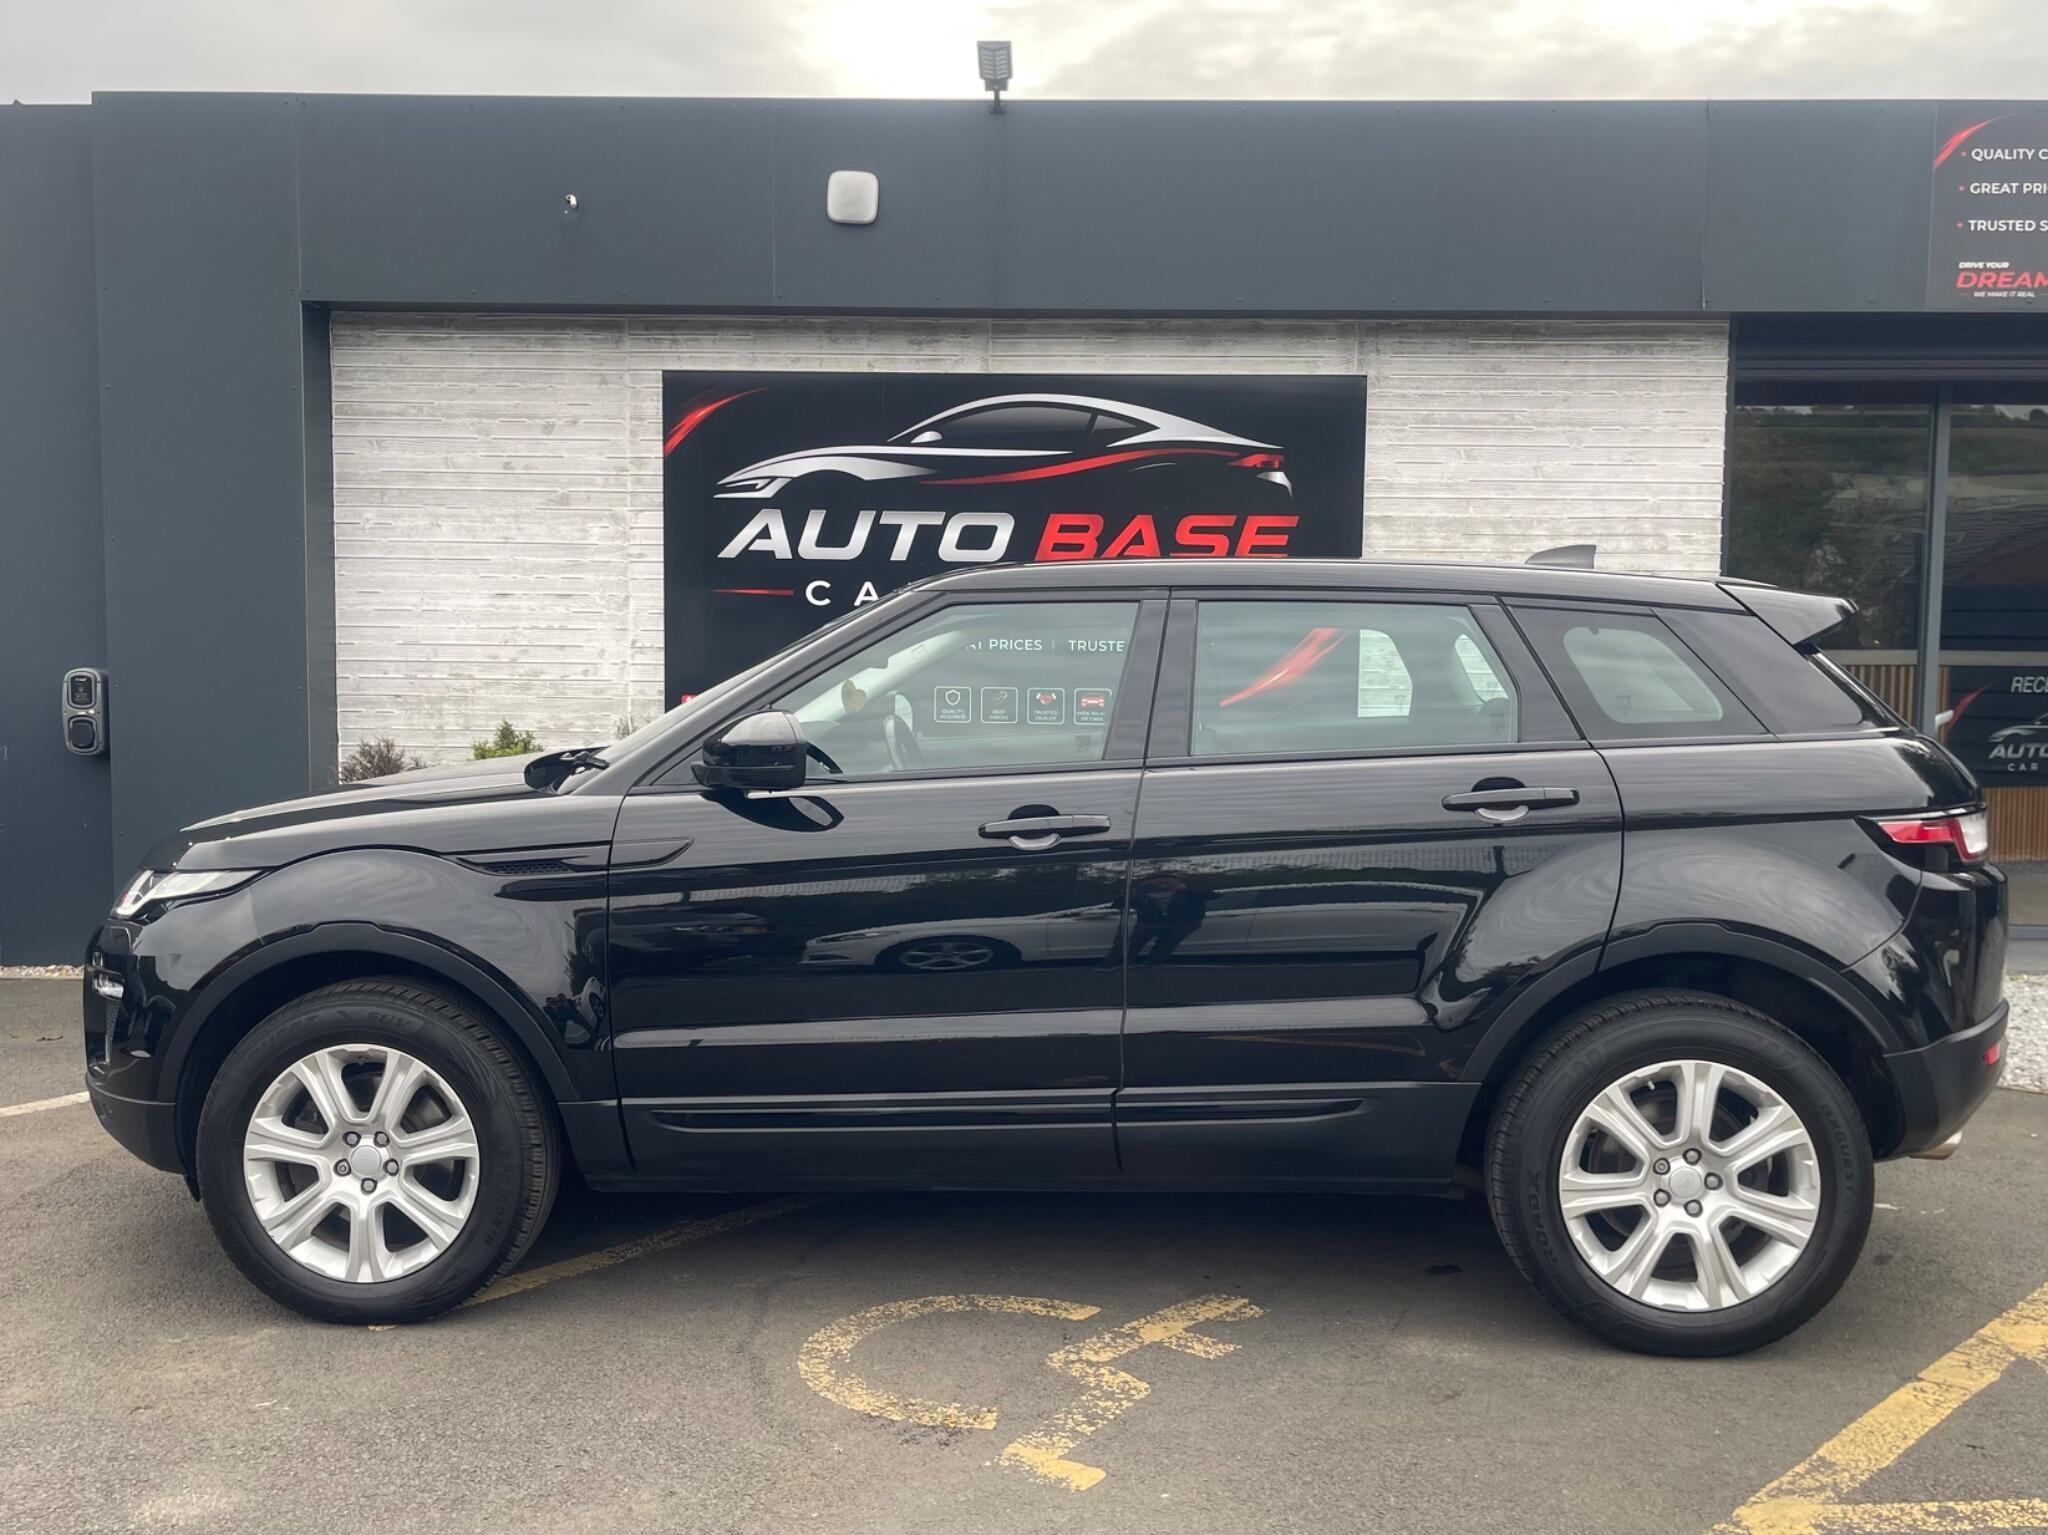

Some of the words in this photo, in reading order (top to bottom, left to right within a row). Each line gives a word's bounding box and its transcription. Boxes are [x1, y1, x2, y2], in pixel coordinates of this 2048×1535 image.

[1971, 148, 2035, 161] QUALITY
[1969, 183, 2019, 194] GREAT
[2022, 183, 2048, 194] PRI
[1968, 220, 2036, 231] TRUSTED
[717, 508, 1016, 562] AUTO
[1034, 513, 1300, 561] BASE
[989, 639, 1043, 651] PRICES
